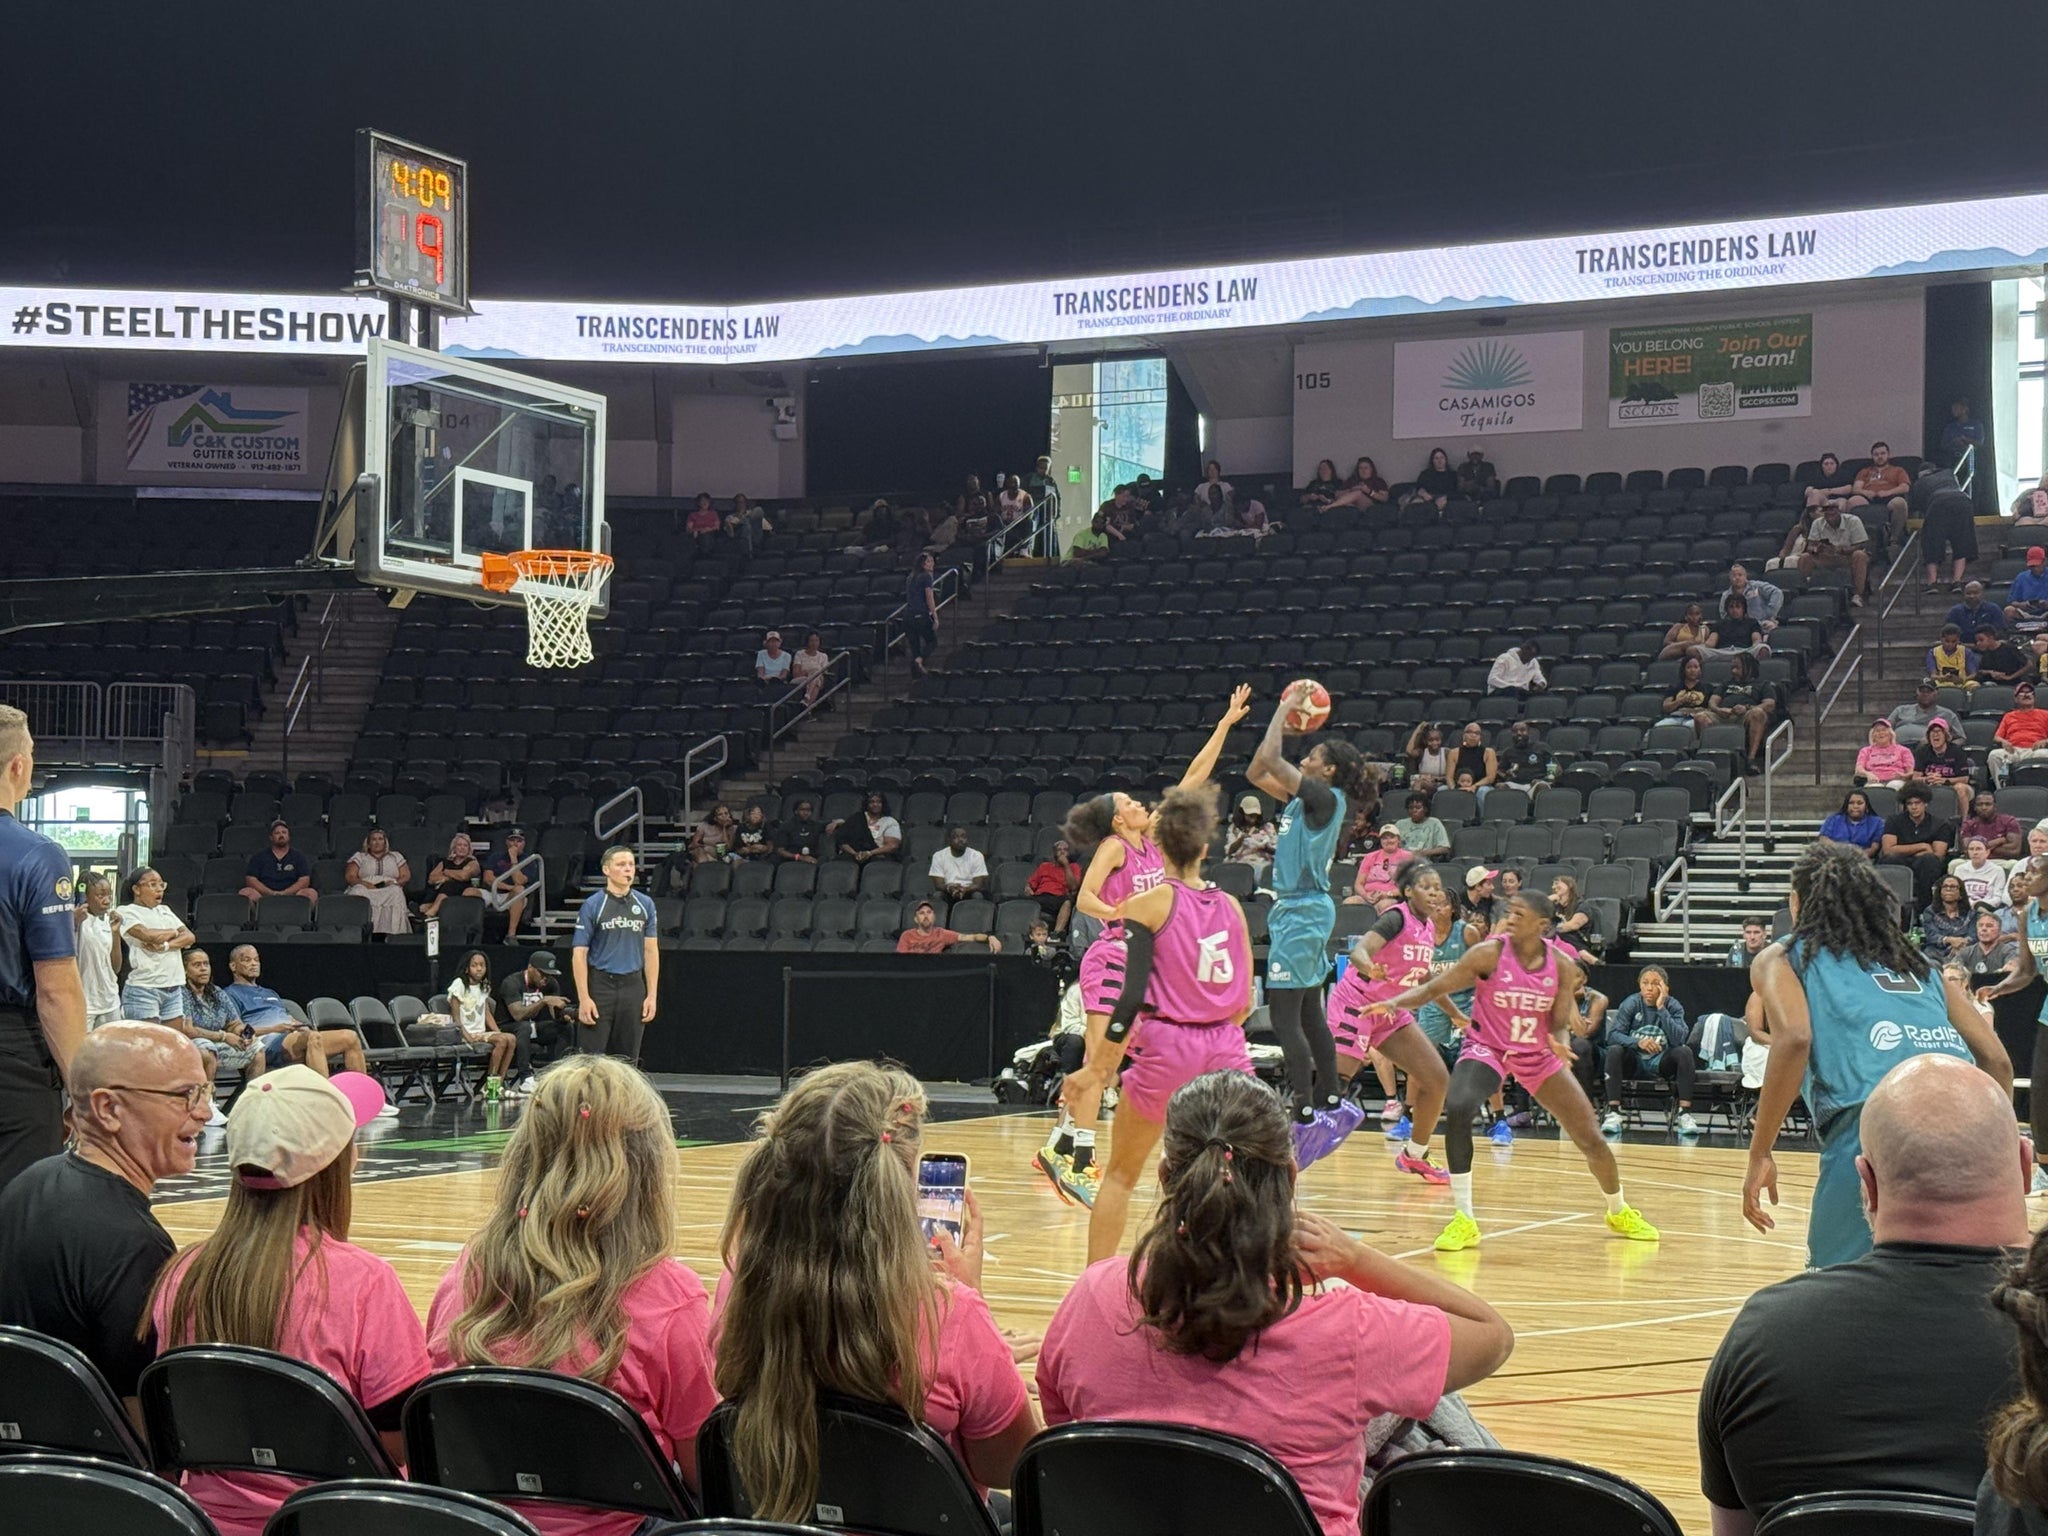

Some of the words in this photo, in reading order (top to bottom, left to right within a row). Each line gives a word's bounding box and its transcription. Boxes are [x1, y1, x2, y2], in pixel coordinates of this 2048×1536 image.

[391, 160, 451, 211] 4:09
[1575, 234, 1759, 274] TRANSCENDENS
[1767, 229, 1816, 258] LAW
[1603, 270, 1696, 288] TRANSCENDING
[1698, 268, 1722, 281] THE
[1724, 263, 1786, 278] ORDINARY
[1053, 281, 1209, 316] TRANSCENDENS
[1216, 278, 1258, 303] LAW
[576, 315, 738, 340] TRANSCENDENS
[744, 315, 780, 339] LAW
[1077, 314, 1155, 329] TRANSCENDING
[1156, 312, 1178, 323] THE
[1179, 308, 1232, 321] ORDINARY
[601, 342, 684, 354] TRANSCENDING
[685, 344, 707, 355] THE
[708, 343, 758, 355] ORDINARY
[1613, 340, 1642, 354] YOU
[1645, 337, 1704, 351] BELONG
[1718, 334, 1760, 353] Join
[1767, 332, 1807, 348] Our
[1624, 355, 1692, 377] HERE!
[1730, 349, 1796, 369] Team!
[1296, 372, 1331, 390] 105
[1439, 393, 1536, 412] CASAMIGOS
[1623, 405, 1674, 417] SCCPSS
[1741, 396, 1796, 407] SCCPSS.COM
[1460, 411, 1514, 431] Tequila
[193, 435, 227, 449] C&K
[231, 436, 299, 450] CUSTOM
[193, 449, 234, 460] GUTTER
[237, 450, 300, 461] SOLUTIONS
[168, 461, 203, 470] VETERAN
[204, 462, 236, 470] OWNED
[1132, 867, 1166, 893] STE
[1402, 944, 1433, 963] STE
[1510, 1015, 1539, 1044] 12
